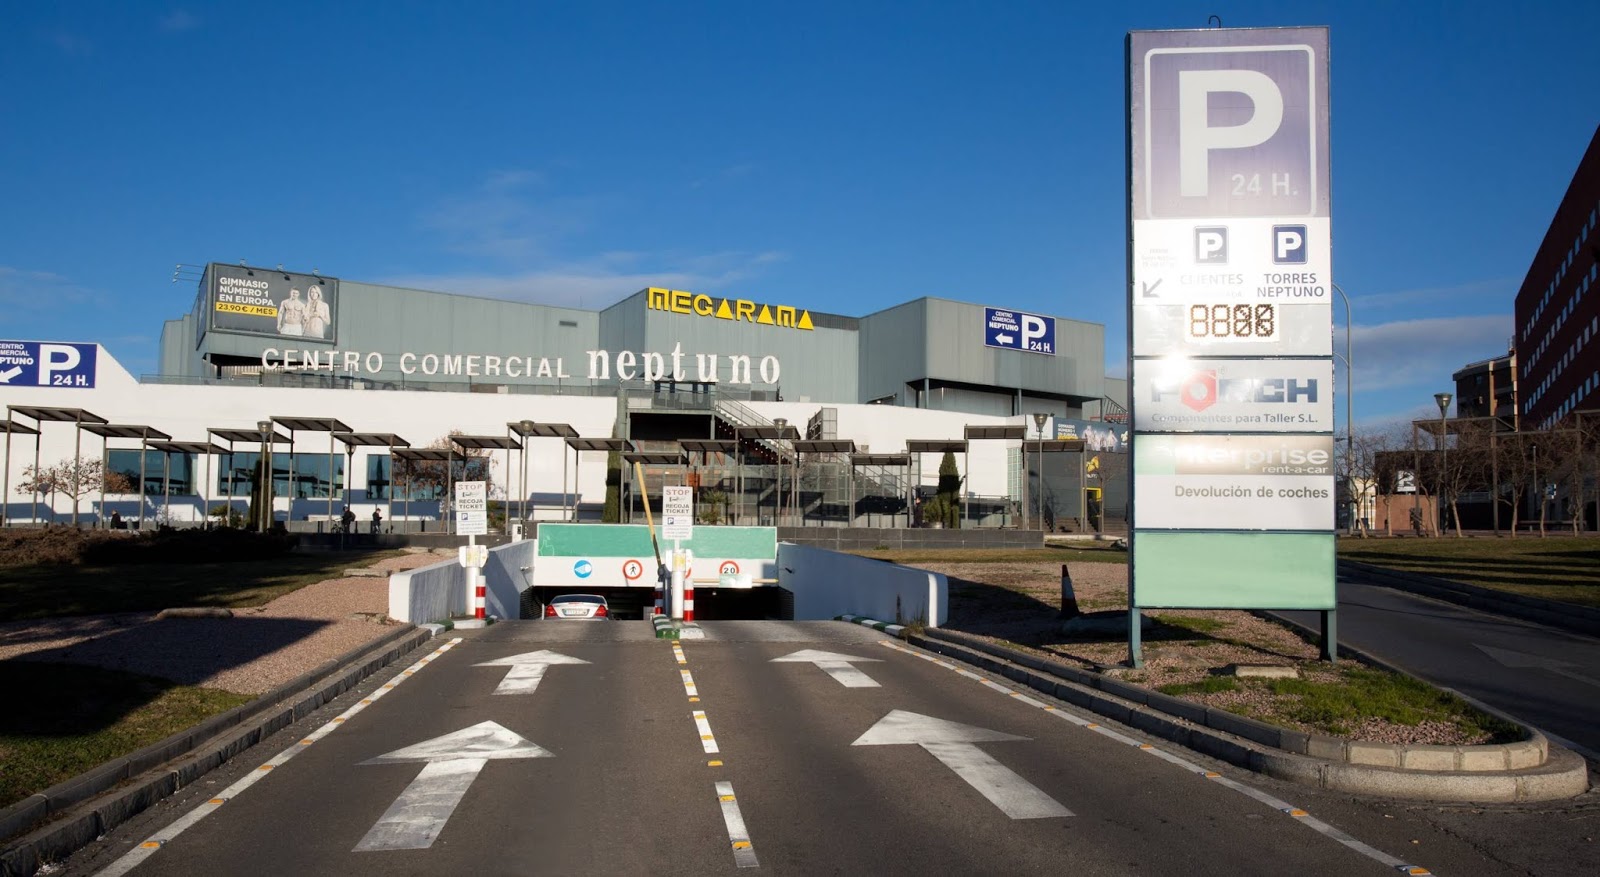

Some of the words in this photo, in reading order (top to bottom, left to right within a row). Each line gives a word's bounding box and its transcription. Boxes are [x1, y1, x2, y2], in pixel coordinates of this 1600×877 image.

[1179, 70, 1283, 197] P
[1231, 174, 1262, 196] 24
[1272, 173, 1298, 196] H.
[1277, 231, 1302, 258] P
[220, 277, 269, 289] GIMNASIO
[1263, 273, 1317, 284] TORRES
[219, 284, 262, 297] NÚMERO
[264, 290, 269, 298] 1
[1257, 286, 1324, 298] NEPTUNO
[219, 294, 233, 302] EN
[236, 296, 277, 307] EUROPA.
[648, 287, 814, 330] MEGARAMA
[988, 321, 1019, 331] NEPTUNO
[991, 316, 1016, 324] COMERCIAL
[1021, 314, 1047, 349] P
[1030, 340, 1042, 351] 24
[1043, 342, 1052, 353] H.
[38, 344, 80, 385] P
[261, 348, 383, 373] CENTRO
[400, 352, 570, 378] COMERCIAL
[585, 341, 781, 385] neptuno
[53, 374, 72, 386] 24
[76, 375, 89, 386] H.
[1151, 413, 1232, 425] Componentes
[1235, 415, 1261, 425] para
[1263, 413, 1295, 423] Taller
[1298, 413, 1318, 423] S.L.
[1262, 465, 1329, 474] rent-a-car
[1174, 485, 1252, 498] Devolución
[1256, 485, 1273, 498] de
[1278, 486, 1329, 498] coches
